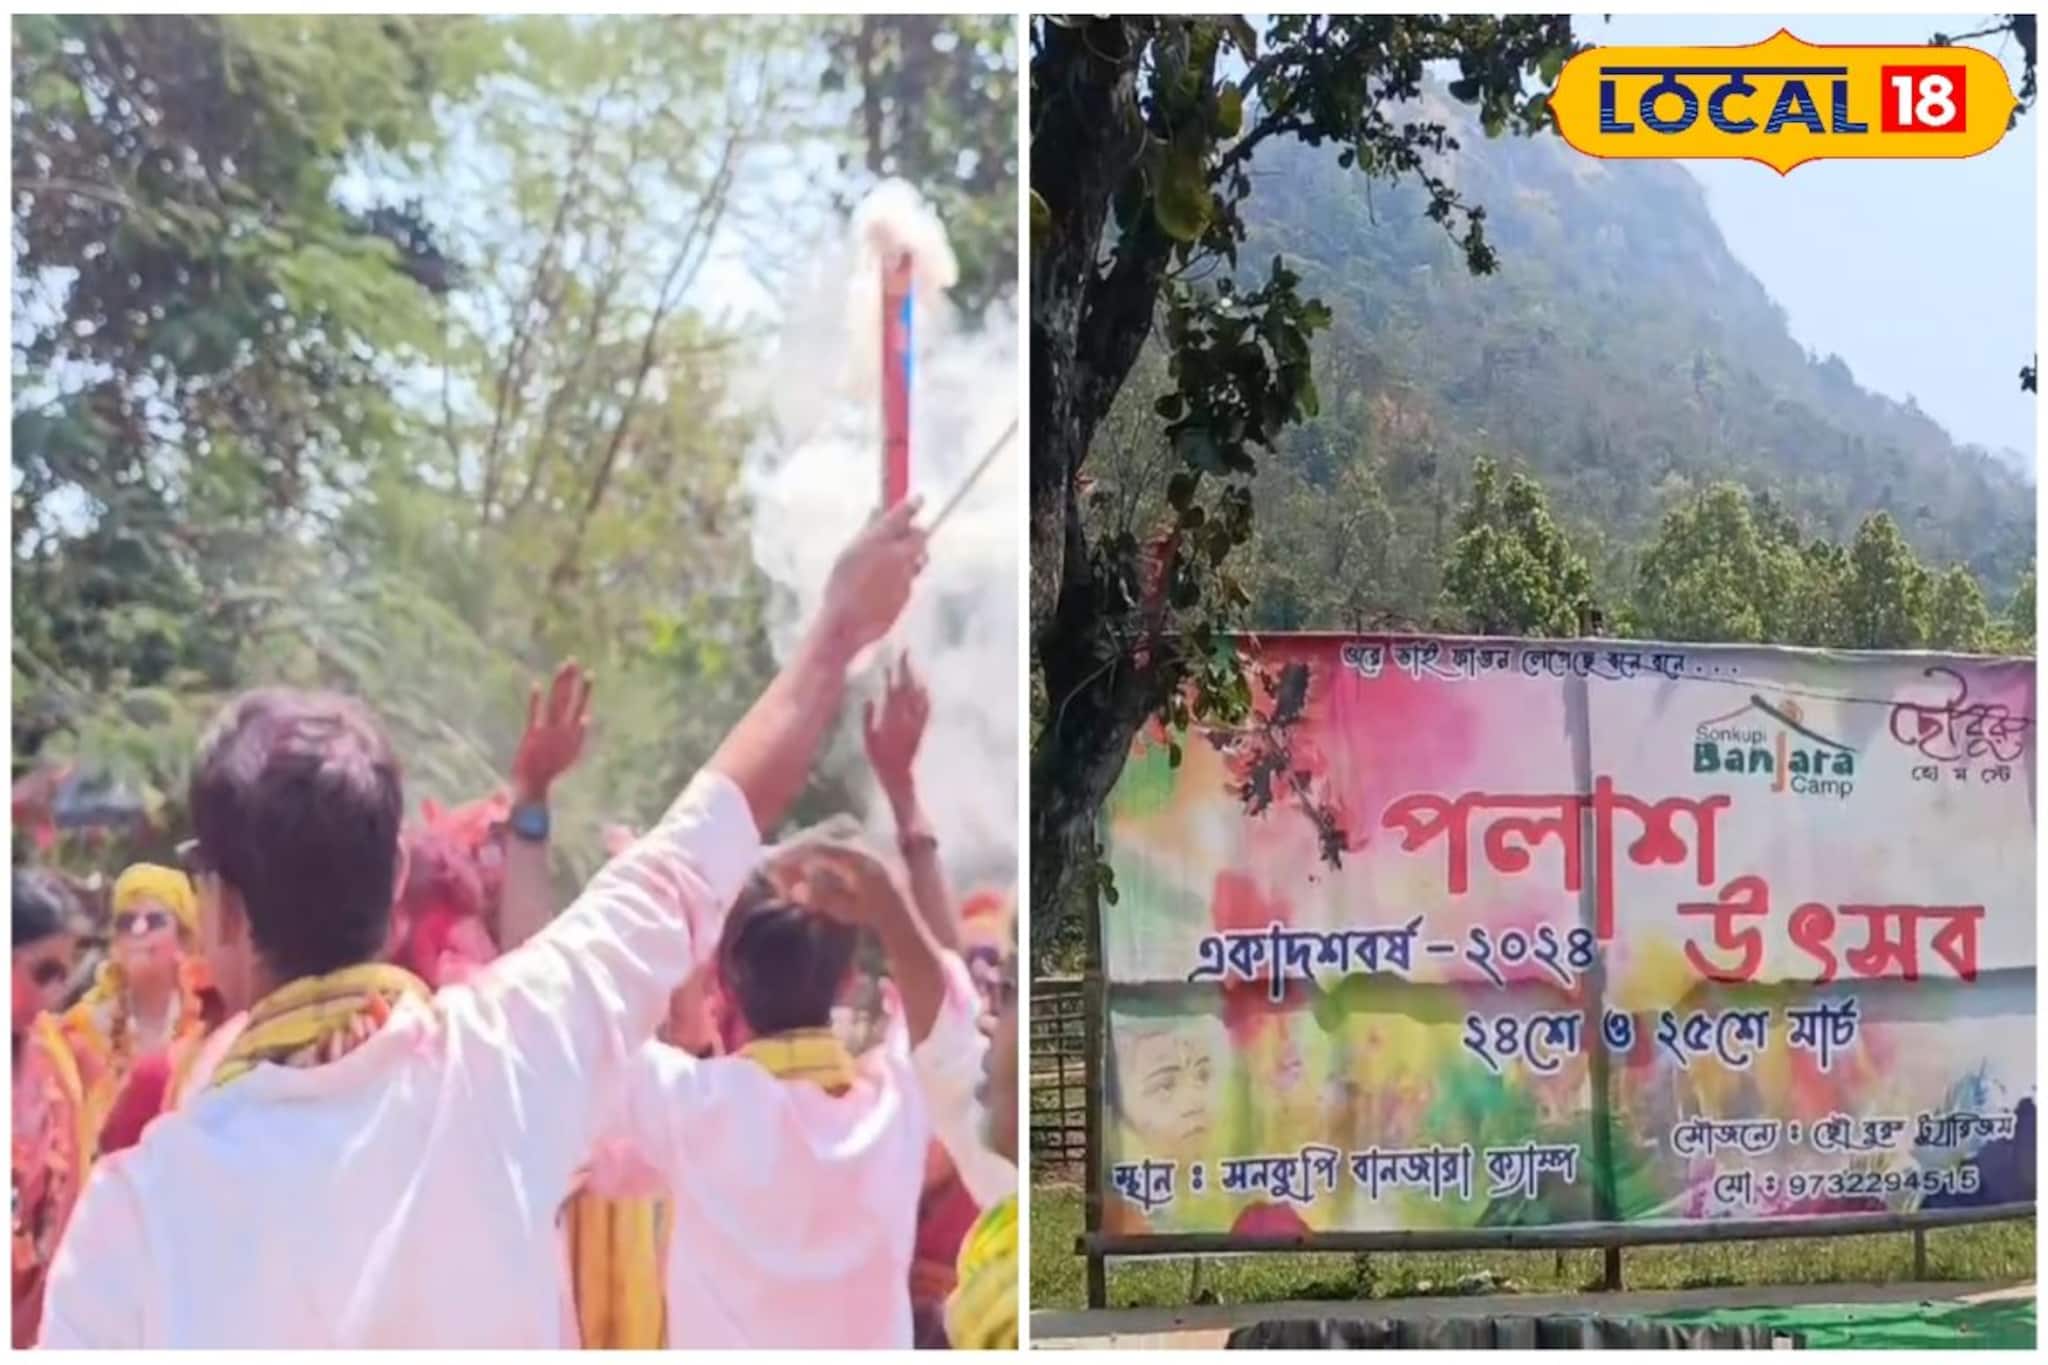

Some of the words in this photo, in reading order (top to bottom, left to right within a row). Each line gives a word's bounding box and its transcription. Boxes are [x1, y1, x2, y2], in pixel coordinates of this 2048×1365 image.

[1397, 642, 1441, 677] ভাই
[1652, 653, 1685, 680] বনে
[1696, 725, 1767, 744] Sonkupi
[1790, 775, 1853, 798] Camp
[1382, 775, 1730, 940] পলাশ
[1190, 916, 1423, 997] একাদশবর্ষ
[1466, 928, 1593, 986] ২০২৪
[1677, 876, 1985, 984] উৎসব
[1464, 1012, 1581, 1069] ২৪শে
[1604, 1013, 1631, 1048] ও
[1658, 1008, 1767, 1064] ২৫শে
[1788, 1004, 1856, 1067] মার্চ
[1115, 1160, 1175, 1210] স্থান
[1222, 1146, 1338, 1202] সনকুপি
[1353, 1148, 1471, 1198] বানজারা
[1489, 1147, 1576, 1196] ক্যাম্প
[1714, 1171, 1750, 1203] মো
[1789, 1168, 1978, 1196] 9732294515
